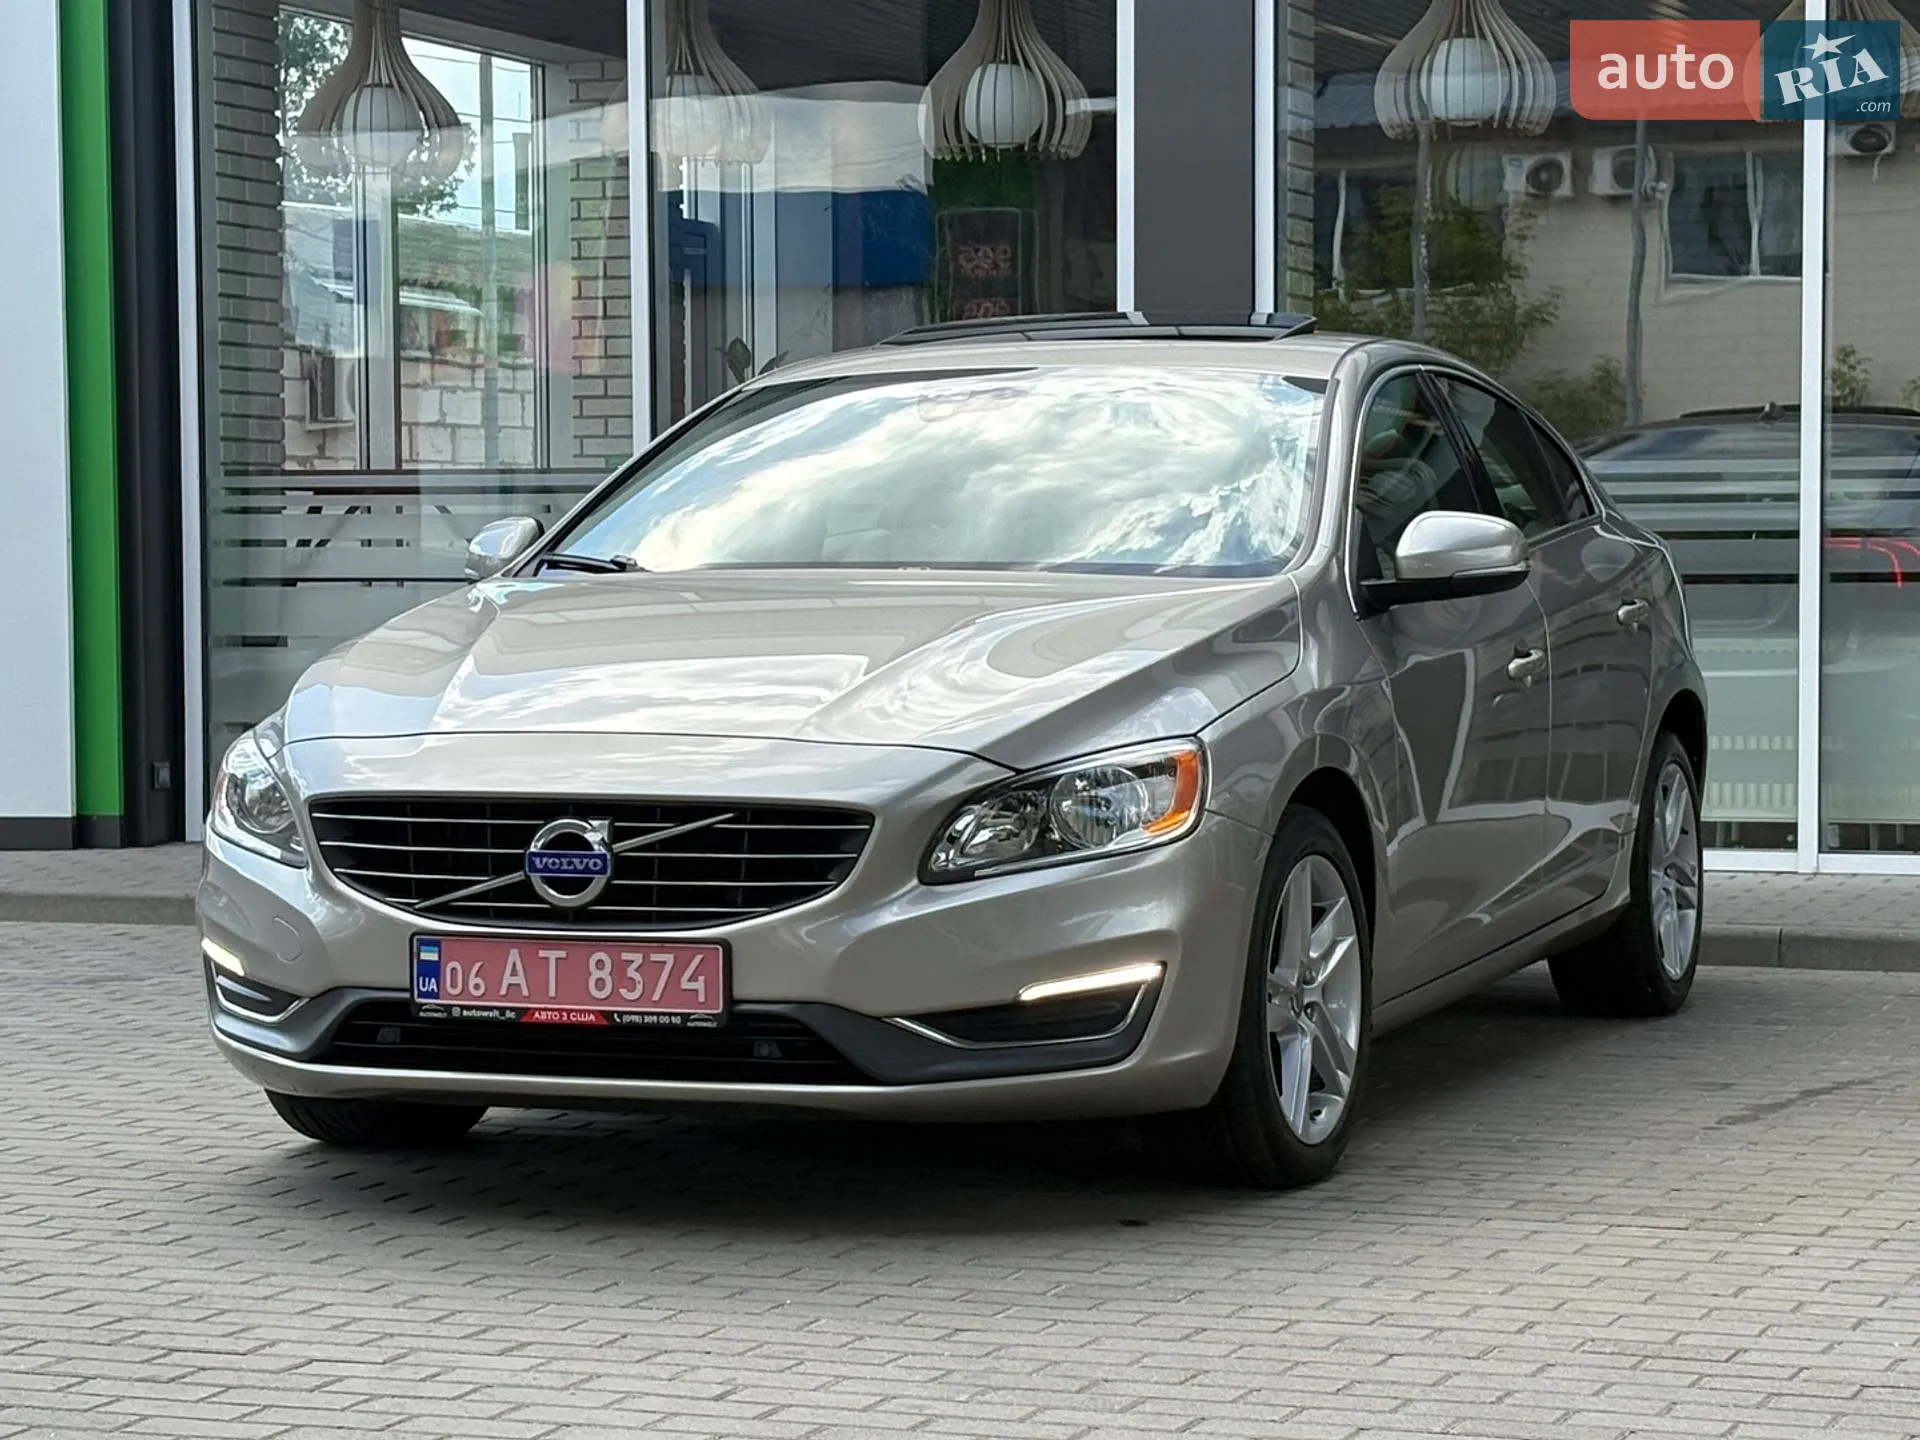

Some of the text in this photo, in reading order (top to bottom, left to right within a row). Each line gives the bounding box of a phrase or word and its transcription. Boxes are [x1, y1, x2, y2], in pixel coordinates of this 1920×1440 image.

[531, 856, 603, 870] VOLVO
[445, 949, 705, 1003] 06 AT 8374
[419, 977, 438, 993] UA
